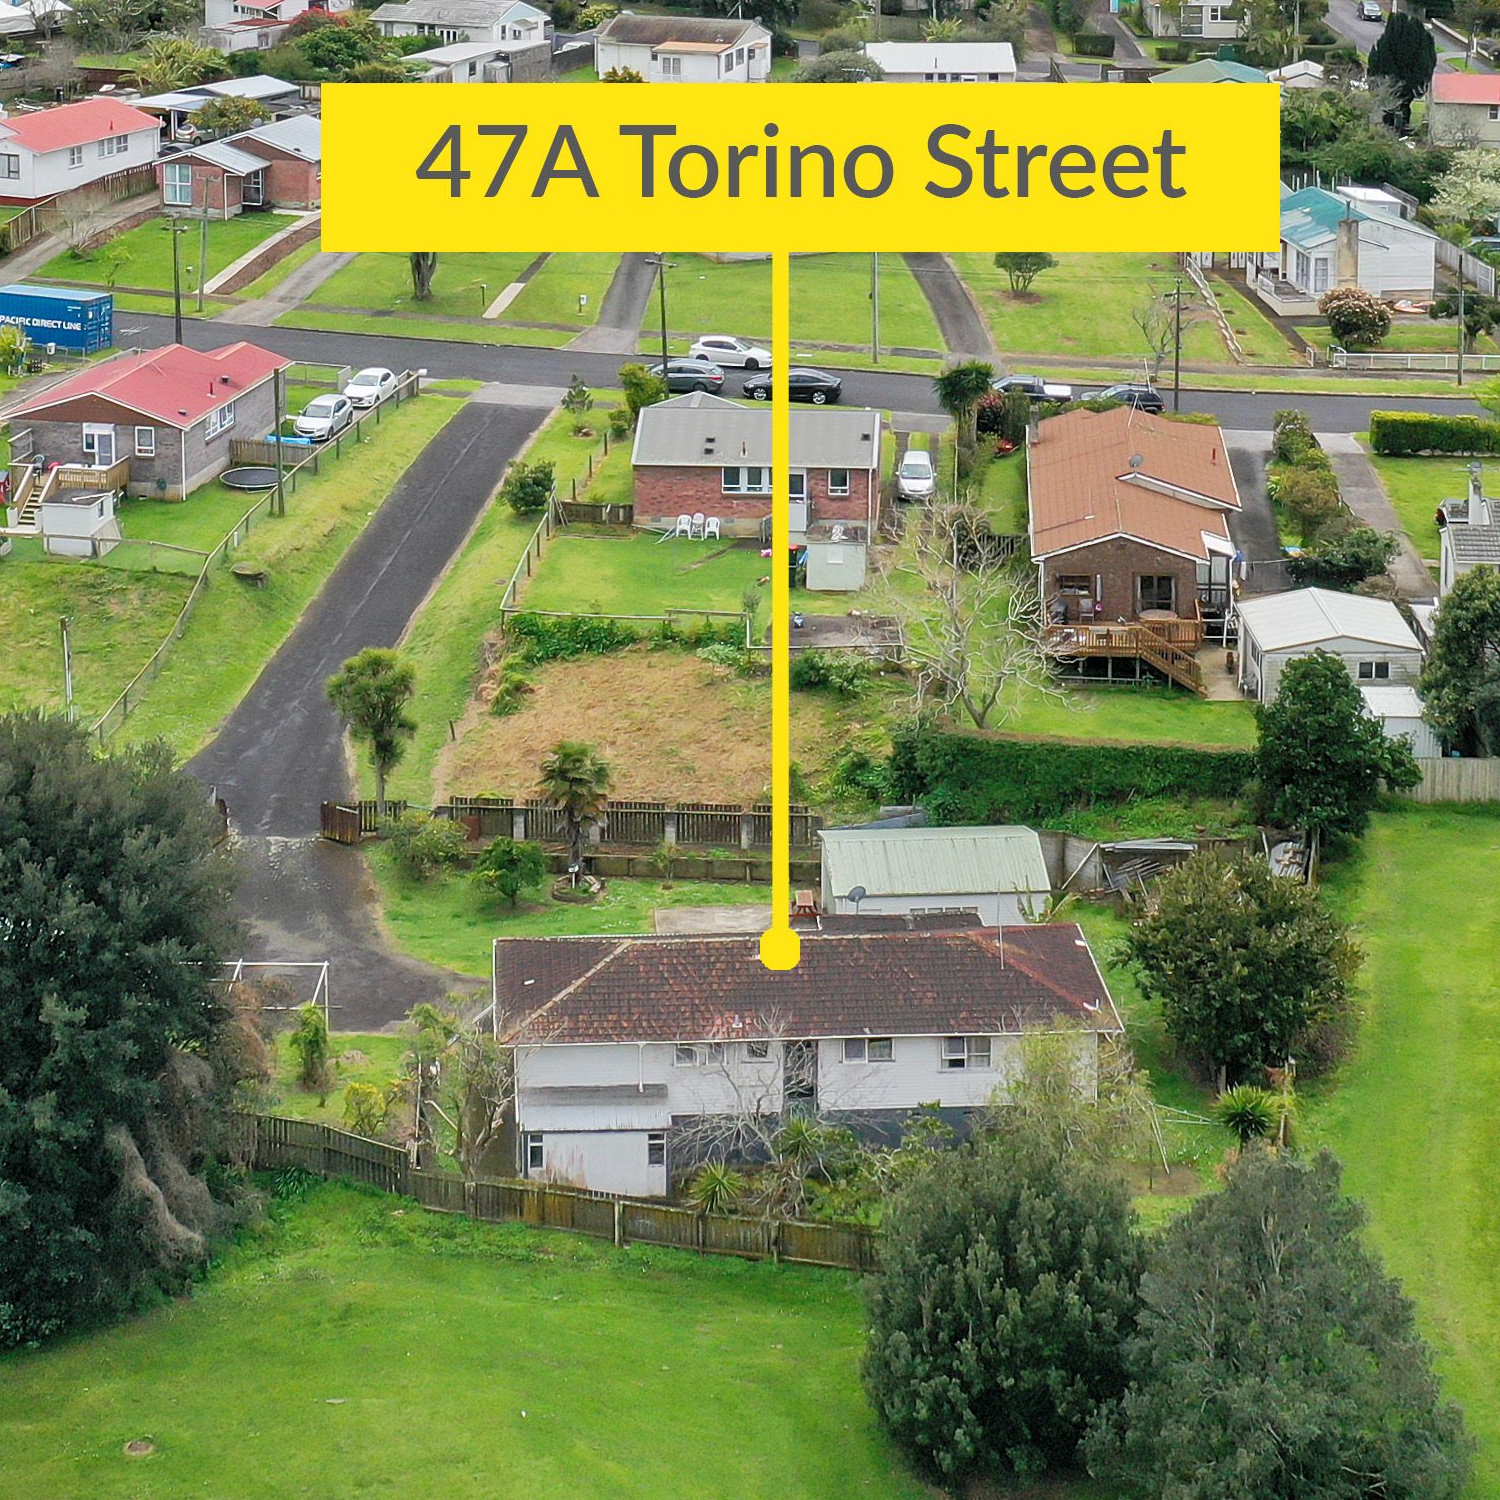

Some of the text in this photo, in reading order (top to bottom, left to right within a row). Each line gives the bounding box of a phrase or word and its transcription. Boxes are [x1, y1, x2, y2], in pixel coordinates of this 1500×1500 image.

[0, 315, 82, 331] PACIFIC DIRECT LINE
